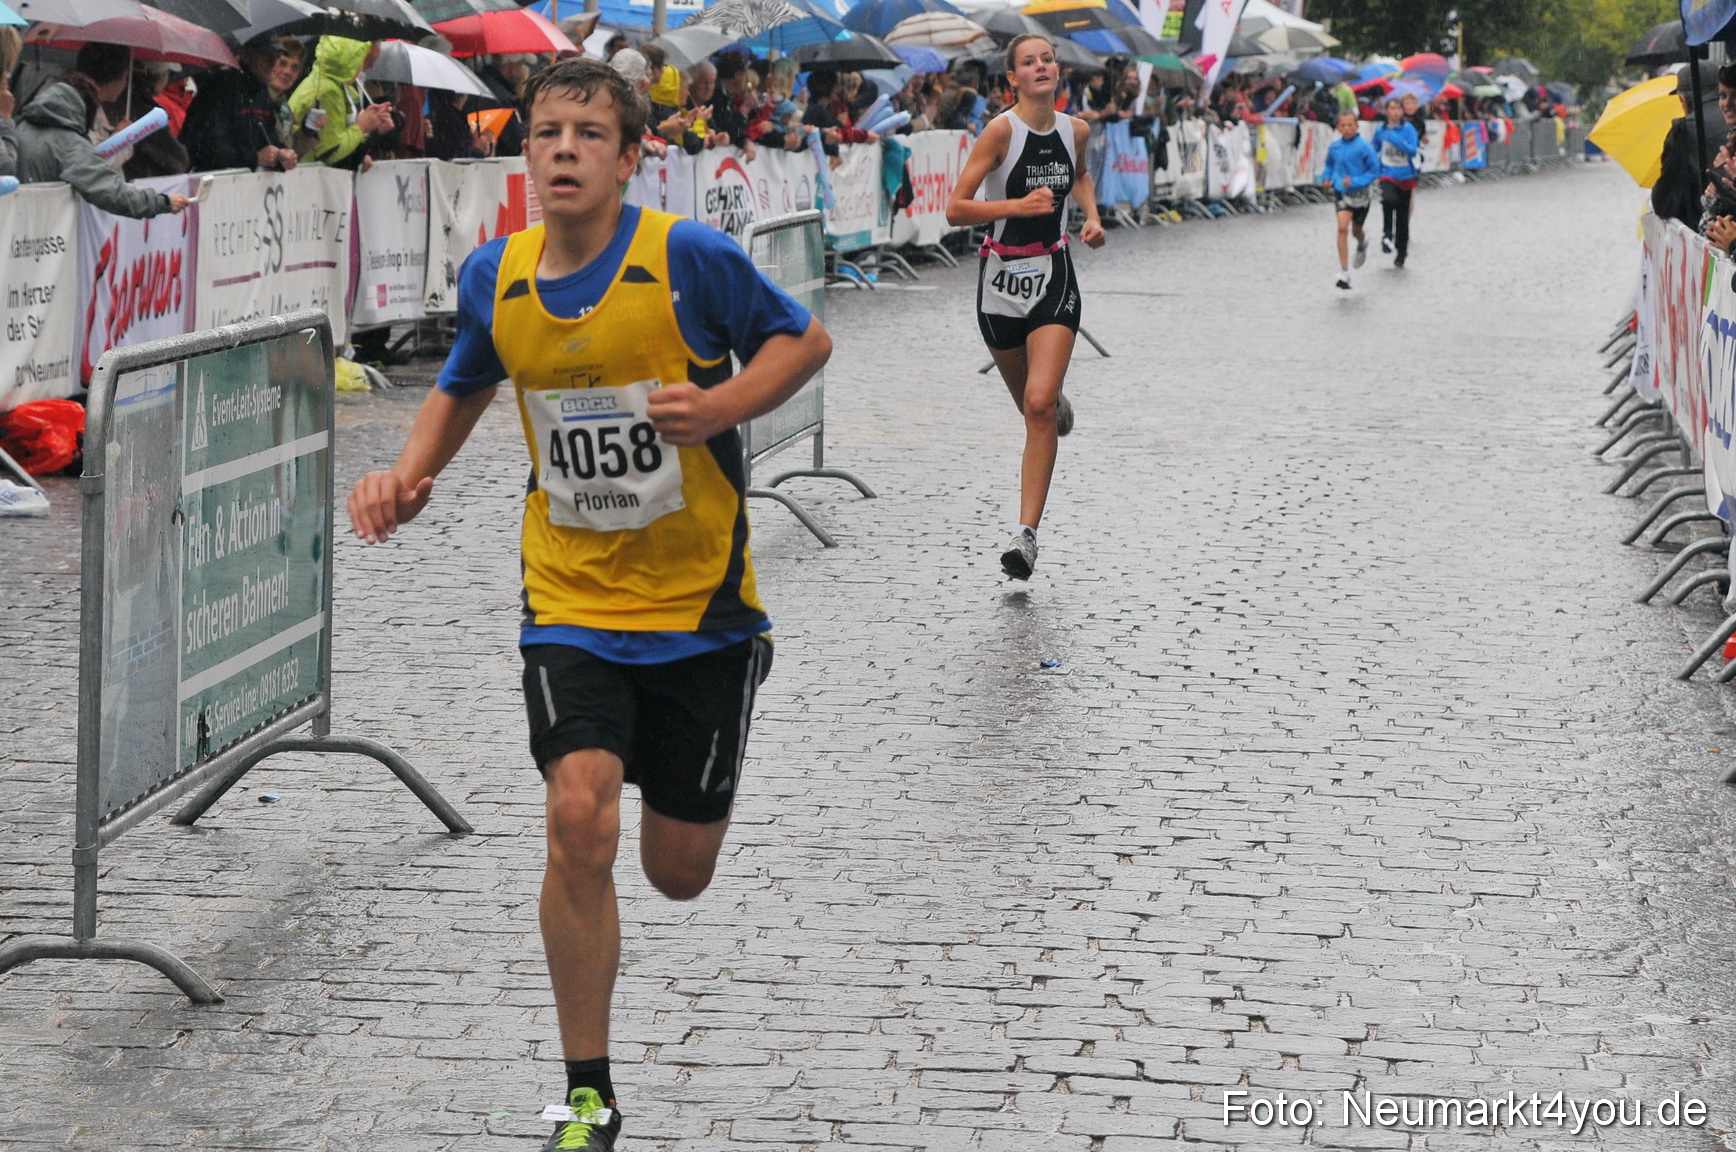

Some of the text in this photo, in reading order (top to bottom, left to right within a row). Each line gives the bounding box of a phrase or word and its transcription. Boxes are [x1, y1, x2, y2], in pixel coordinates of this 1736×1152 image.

[1026, 163, 1069, 176] TRIATHLON
[213, 218, 261, 257] RECHTS
[991, 270, 1045, 299] 4097
[212, 384, 281, 426] Event-Leit-Systeme
[561, 396, 618, 412] BOCK
[550, 422, 662, 480] 4058
[574, 490, 640, 512] Florian
[188, 484, 281, 570] Fun & Action in
[186, 557, 289, 654] sicheren Bahnen!
[214, 691, 240, 734] Service
[260, 667, 280, 707] 09181
[281, 657, 299, 695] 6352
